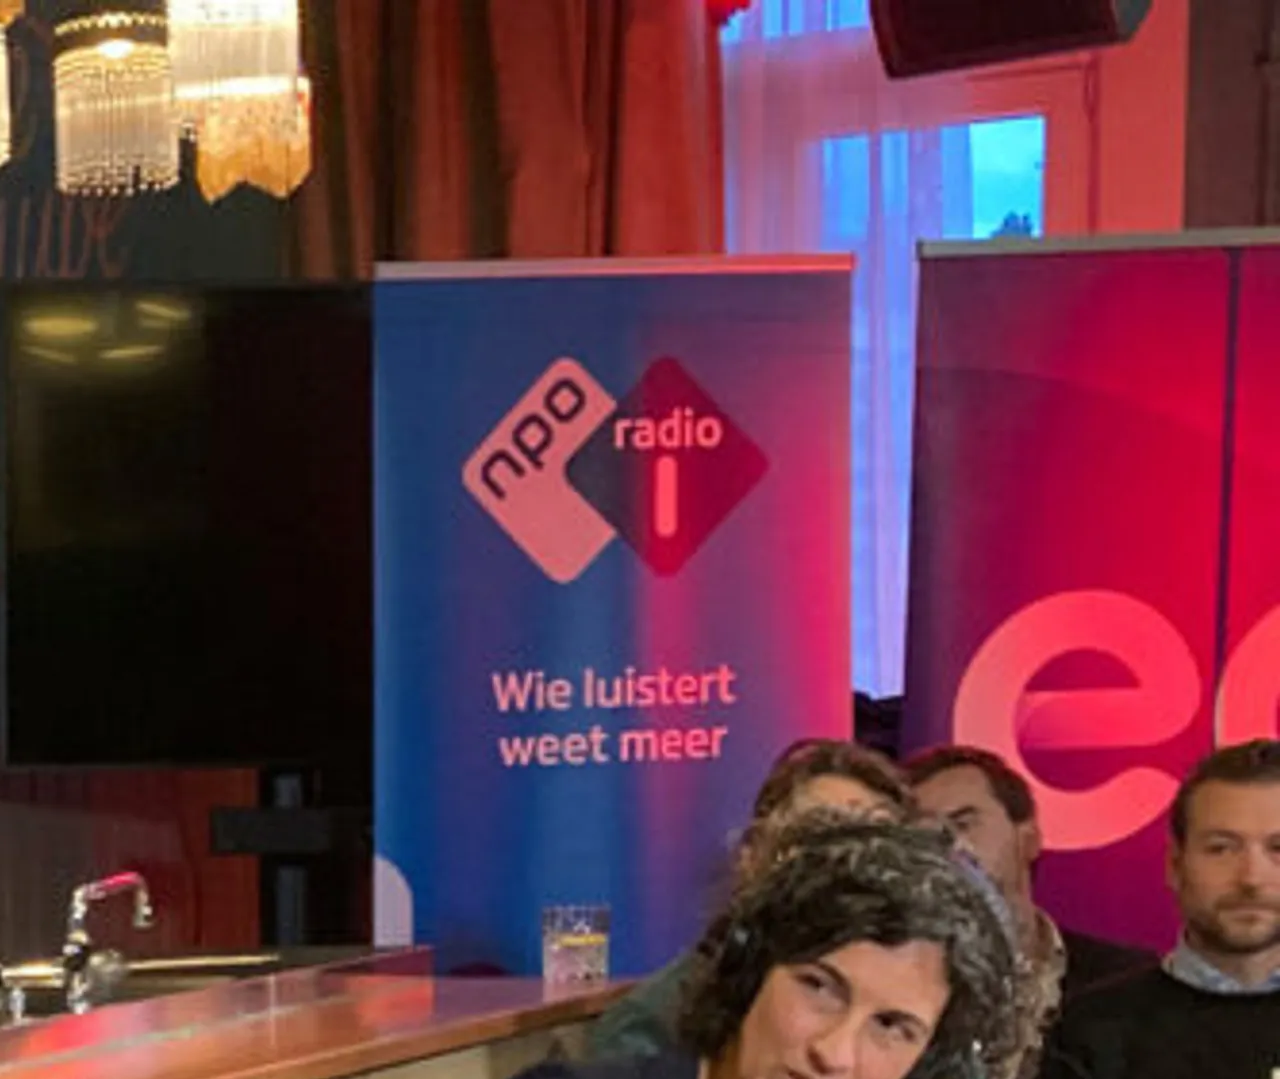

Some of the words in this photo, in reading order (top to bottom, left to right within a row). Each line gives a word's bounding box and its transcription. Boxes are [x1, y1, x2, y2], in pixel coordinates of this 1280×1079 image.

[481, 377, 587, 501] npo
[613, 406, 724, 449] radio
[491, 670, 574, 712] Wie
[584, 663, 738, 708] luistert
[953, 590, 1280, 850] e
[498, 725, 610, 767] weet
[619, 725, 729, 762] meer
